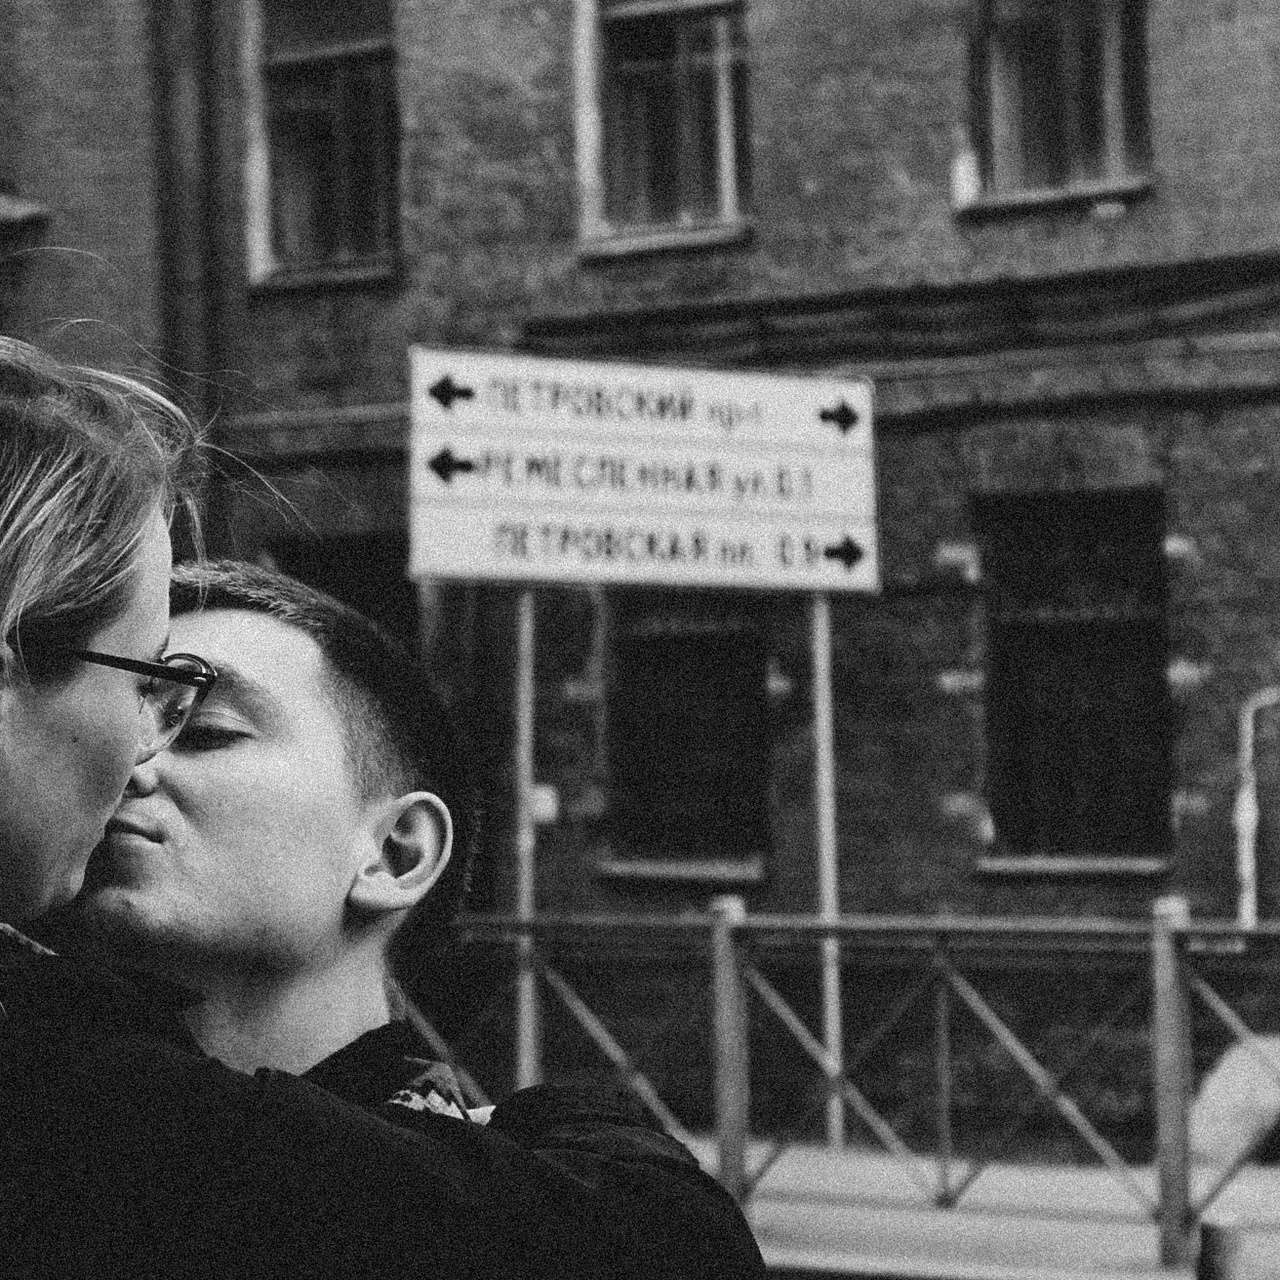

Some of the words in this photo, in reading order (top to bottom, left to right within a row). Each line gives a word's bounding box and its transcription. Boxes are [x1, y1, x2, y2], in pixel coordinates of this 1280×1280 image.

[484, 377, 692, 422] ПЕТРОВСКИЙ
[479, 450, 723, 493] РЕМЕСЛЕННАЯ
[494, 520, 706, 561] ПЕТРОВСКАЯ
